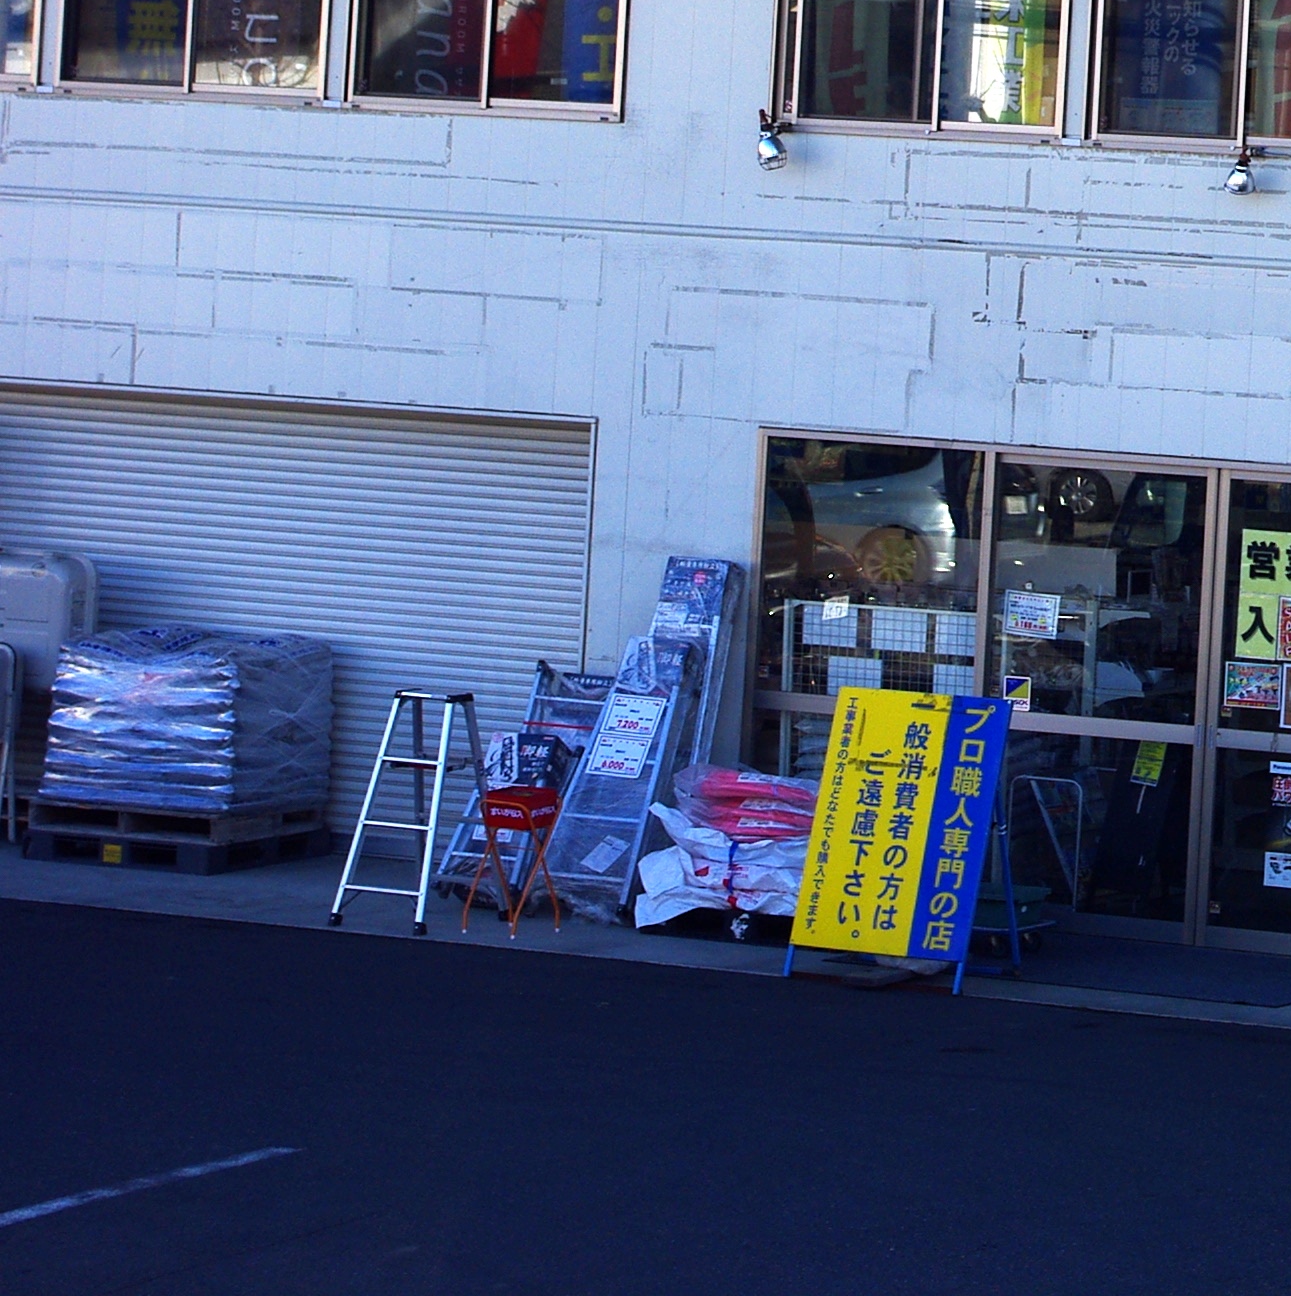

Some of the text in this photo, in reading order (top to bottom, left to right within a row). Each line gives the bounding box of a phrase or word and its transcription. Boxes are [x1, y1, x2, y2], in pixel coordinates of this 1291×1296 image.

[872, 701, 936, 931] 一般消費者の方は
[921, 704, 997, 952] プロ職人専門の店
